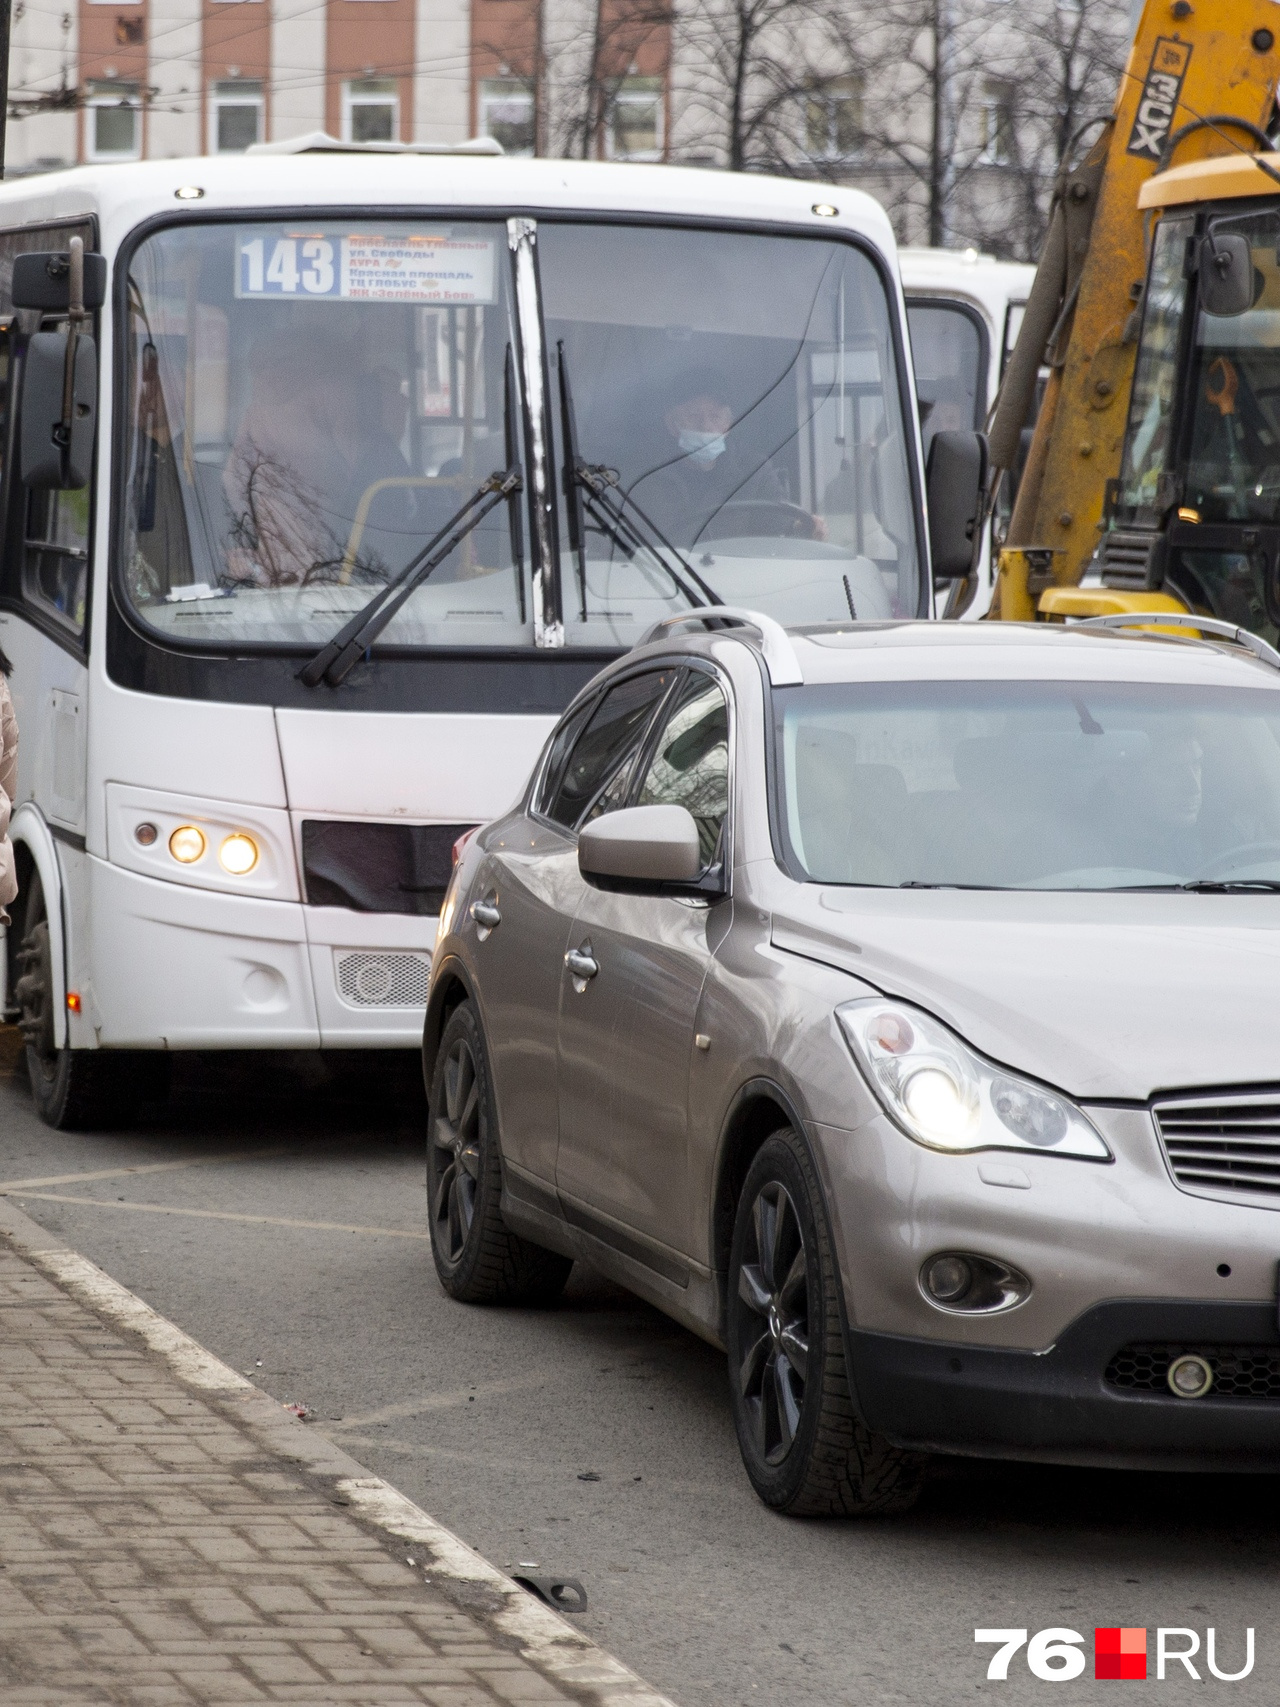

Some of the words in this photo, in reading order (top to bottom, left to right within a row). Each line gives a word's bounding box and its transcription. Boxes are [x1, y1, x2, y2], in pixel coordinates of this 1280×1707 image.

[371, 249, 434, 259] Свободы
[241, 239, 335, 294] 143
[349, 258, 380, 267] АУРА
[349, 268, 406, 278] Красная
[409, 271, 473, 280] площадь
[349, 279, 365, 288] ТЦ
[367, 279, 417, 288] ГЛОБУС
[349, 288, 369, 298] ЖК
